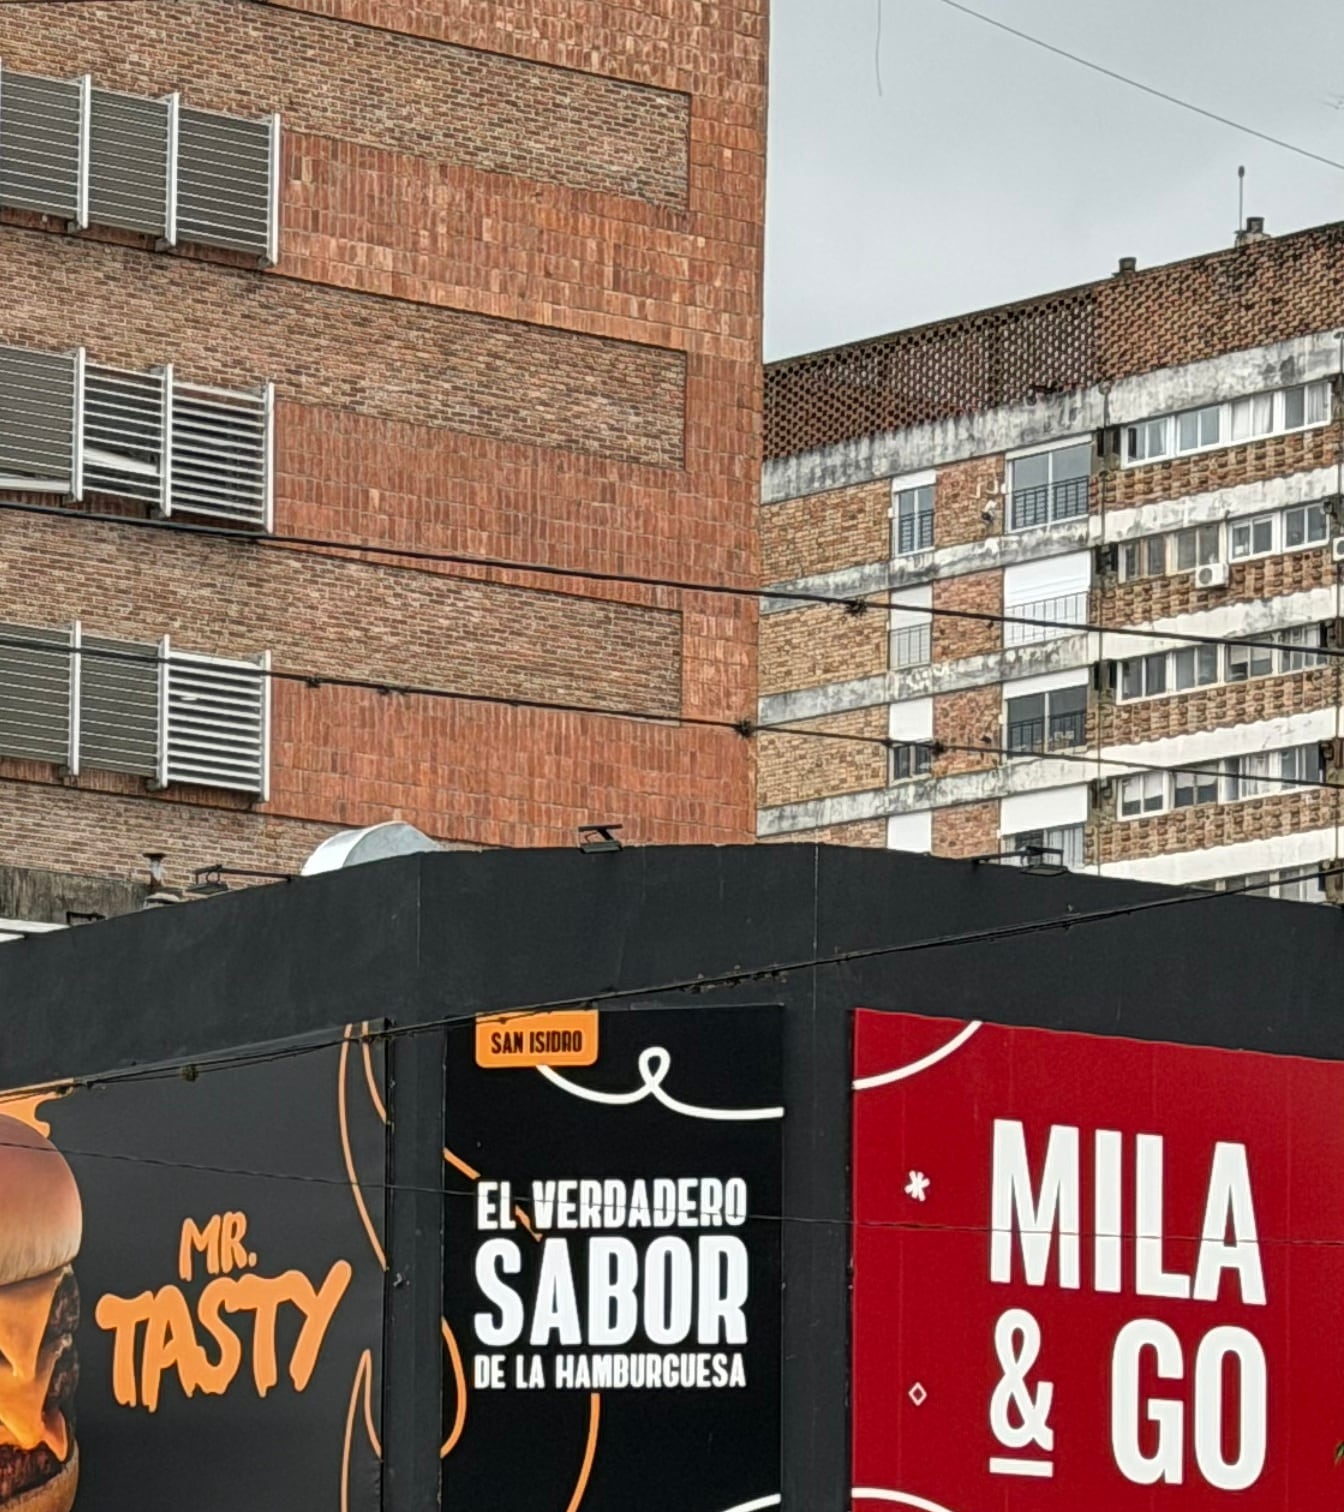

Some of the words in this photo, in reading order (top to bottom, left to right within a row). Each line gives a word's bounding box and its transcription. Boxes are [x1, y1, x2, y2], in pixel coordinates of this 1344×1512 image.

[491, 1031, 523, 1054] SAN
[529, 1030, 583, 1054] ISIDRO
[179, 1211, 258, 1278] MR.
[477, 1180, 516, 1230] EL
[532, 1178, 748, 1229] VERDADERO
[989, 1119, 1268, 1306] MILA
[96, 1260, 352, 1411] TASTY
[474, 1235, 749, 1347] SABOR
[474, 1354, 505, 1389] DE
[516, 1354, 545, 1389] LA
[555, 1353, 747, 1389] HAMBURGUESA
[989, 1308, 1054, 1453] &
[1111, 1318, 1267, 1491] GO
